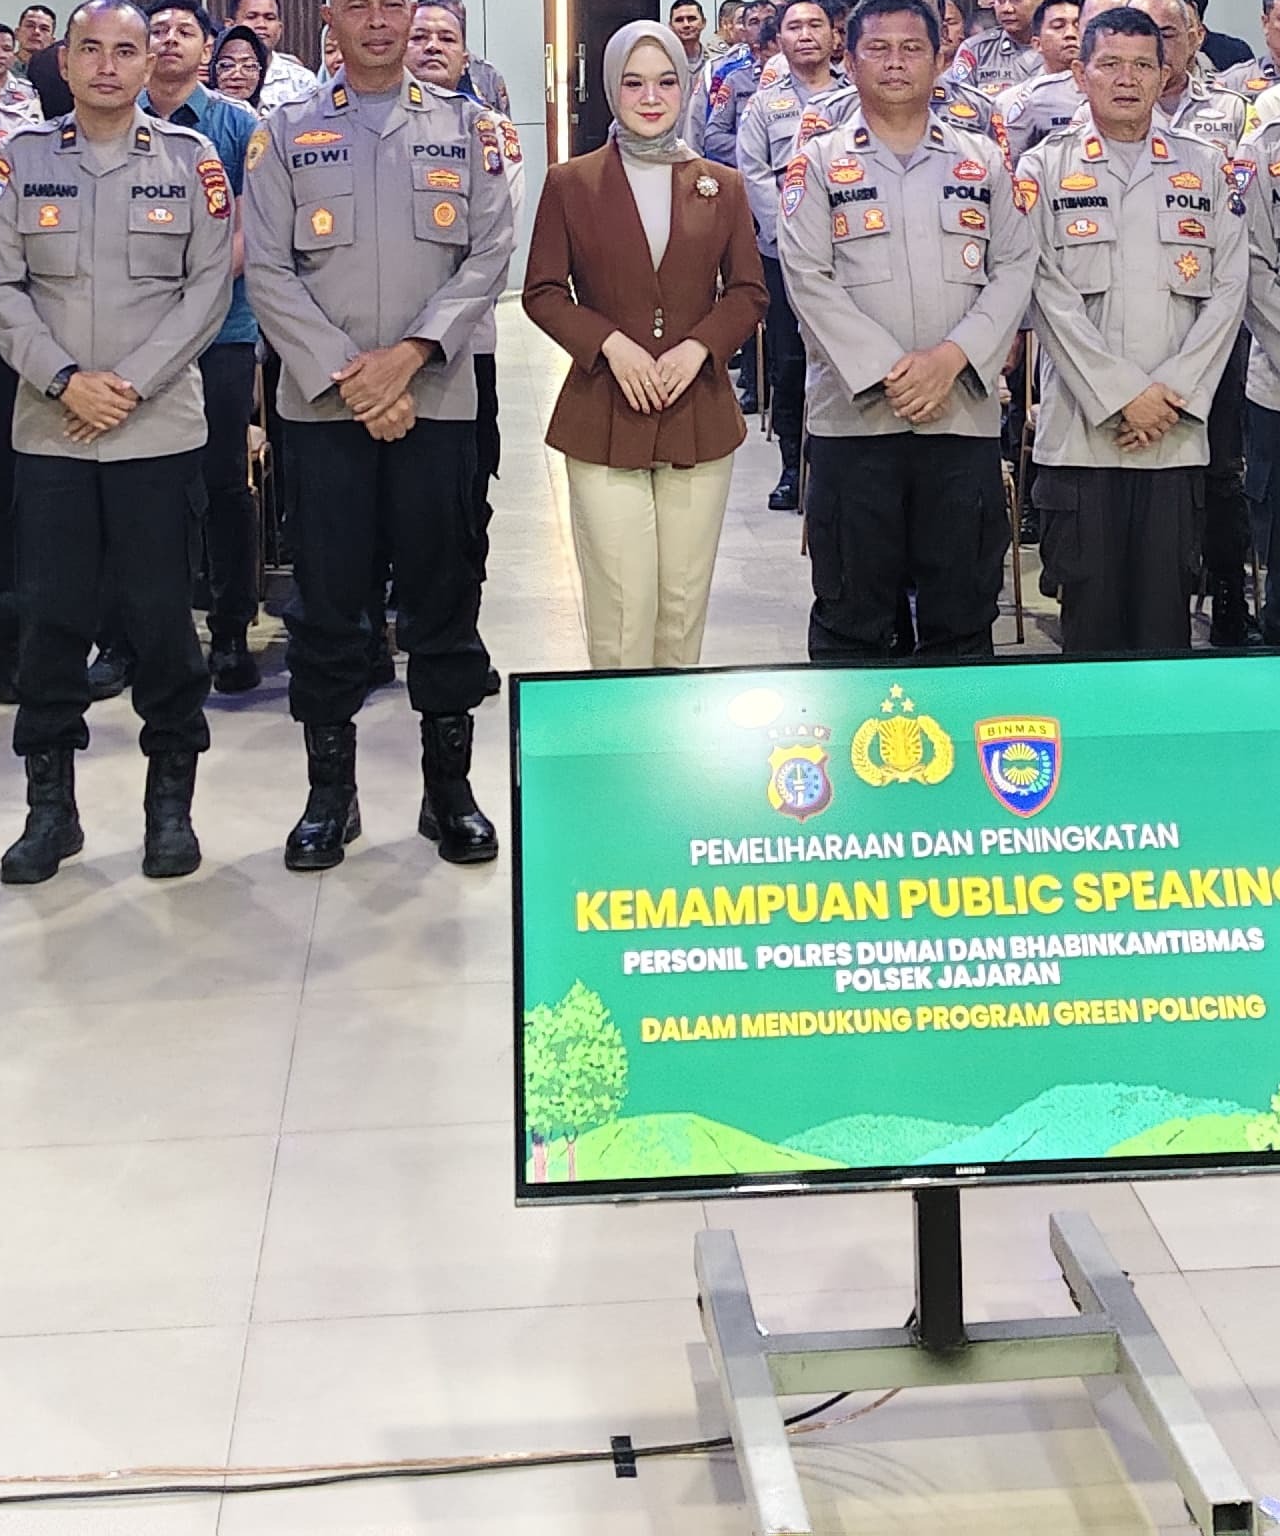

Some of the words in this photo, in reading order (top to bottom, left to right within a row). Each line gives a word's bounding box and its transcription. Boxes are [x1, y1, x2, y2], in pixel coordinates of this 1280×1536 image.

[1194, 122, 1234, 133] POLRI
[291, 148, 349, 169] EDWI
[413, 145, 467, 160] POLRI
[23, 183, 78, 198] BAMBANG
[131, 185, 187, 199] POLRI
[1166, 194, 1211, 212] POLRI
[987, 723, 1048, 736] BINMAS
[690, 832, 905, 866] PEMELIHARAAN
[911, 829, 973, 859] DAN
[981, 822, 1180, 855] PENINGKATAN
[576, 880, 890, 932] KEMAMPUAN
[899, 874, 1064, 919] PUBLIC
[623, 946, 749, 975] PERSONIL
[756, 942, 853, 970] POLRES
[856, 939, 944, 965] DUMAI
[948, 936, 1006, 962] DAN
[1009, 927, 1265, 960] BHABINKAMTIBMAS
[835, 965, 934, 993] POLSEK
[937, 961, 1061, 989] JAJARAN
[641, 1014, 737, 1043] DALAM
[741, 1007, 912, 1039] MENDUKUNG
[915, 1001, 1050, 1032] PROGRAM
[1053, 997, 1139, 1026] GREEN
[1142, 994, 1267, 1023] POLICING
